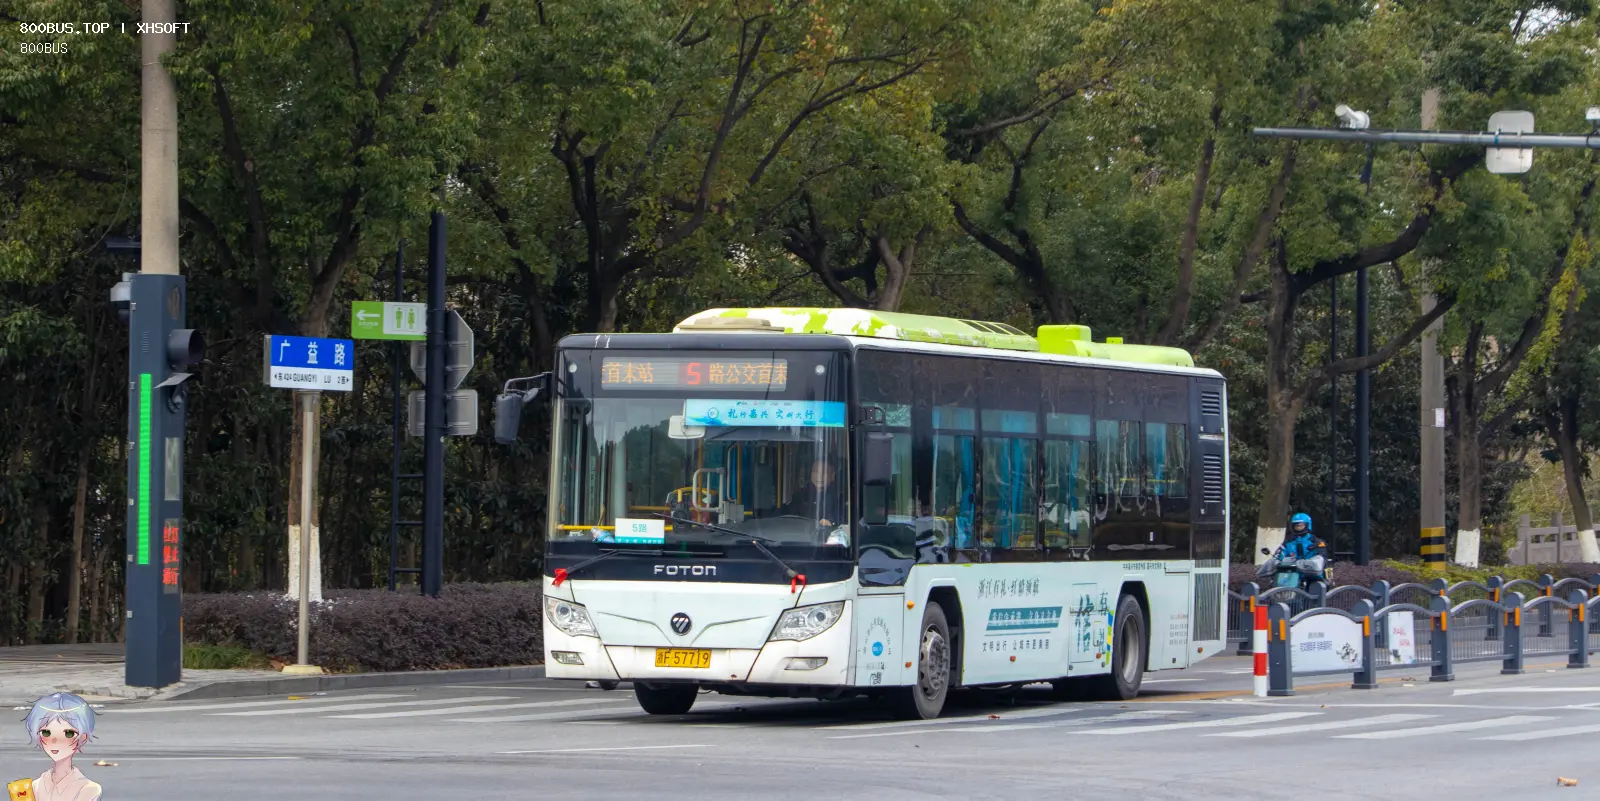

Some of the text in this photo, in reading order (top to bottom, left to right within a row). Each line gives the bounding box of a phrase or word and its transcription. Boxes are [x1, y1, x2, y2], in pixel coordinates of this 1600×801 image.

[279, 339, 345, 366] 广益路
[293, 373, 317, 384] GUANGYI
[324, 375, 332, 384] LU
[687, 362, 701, 385] 5
[653, 564, 717, 576] FOTON
